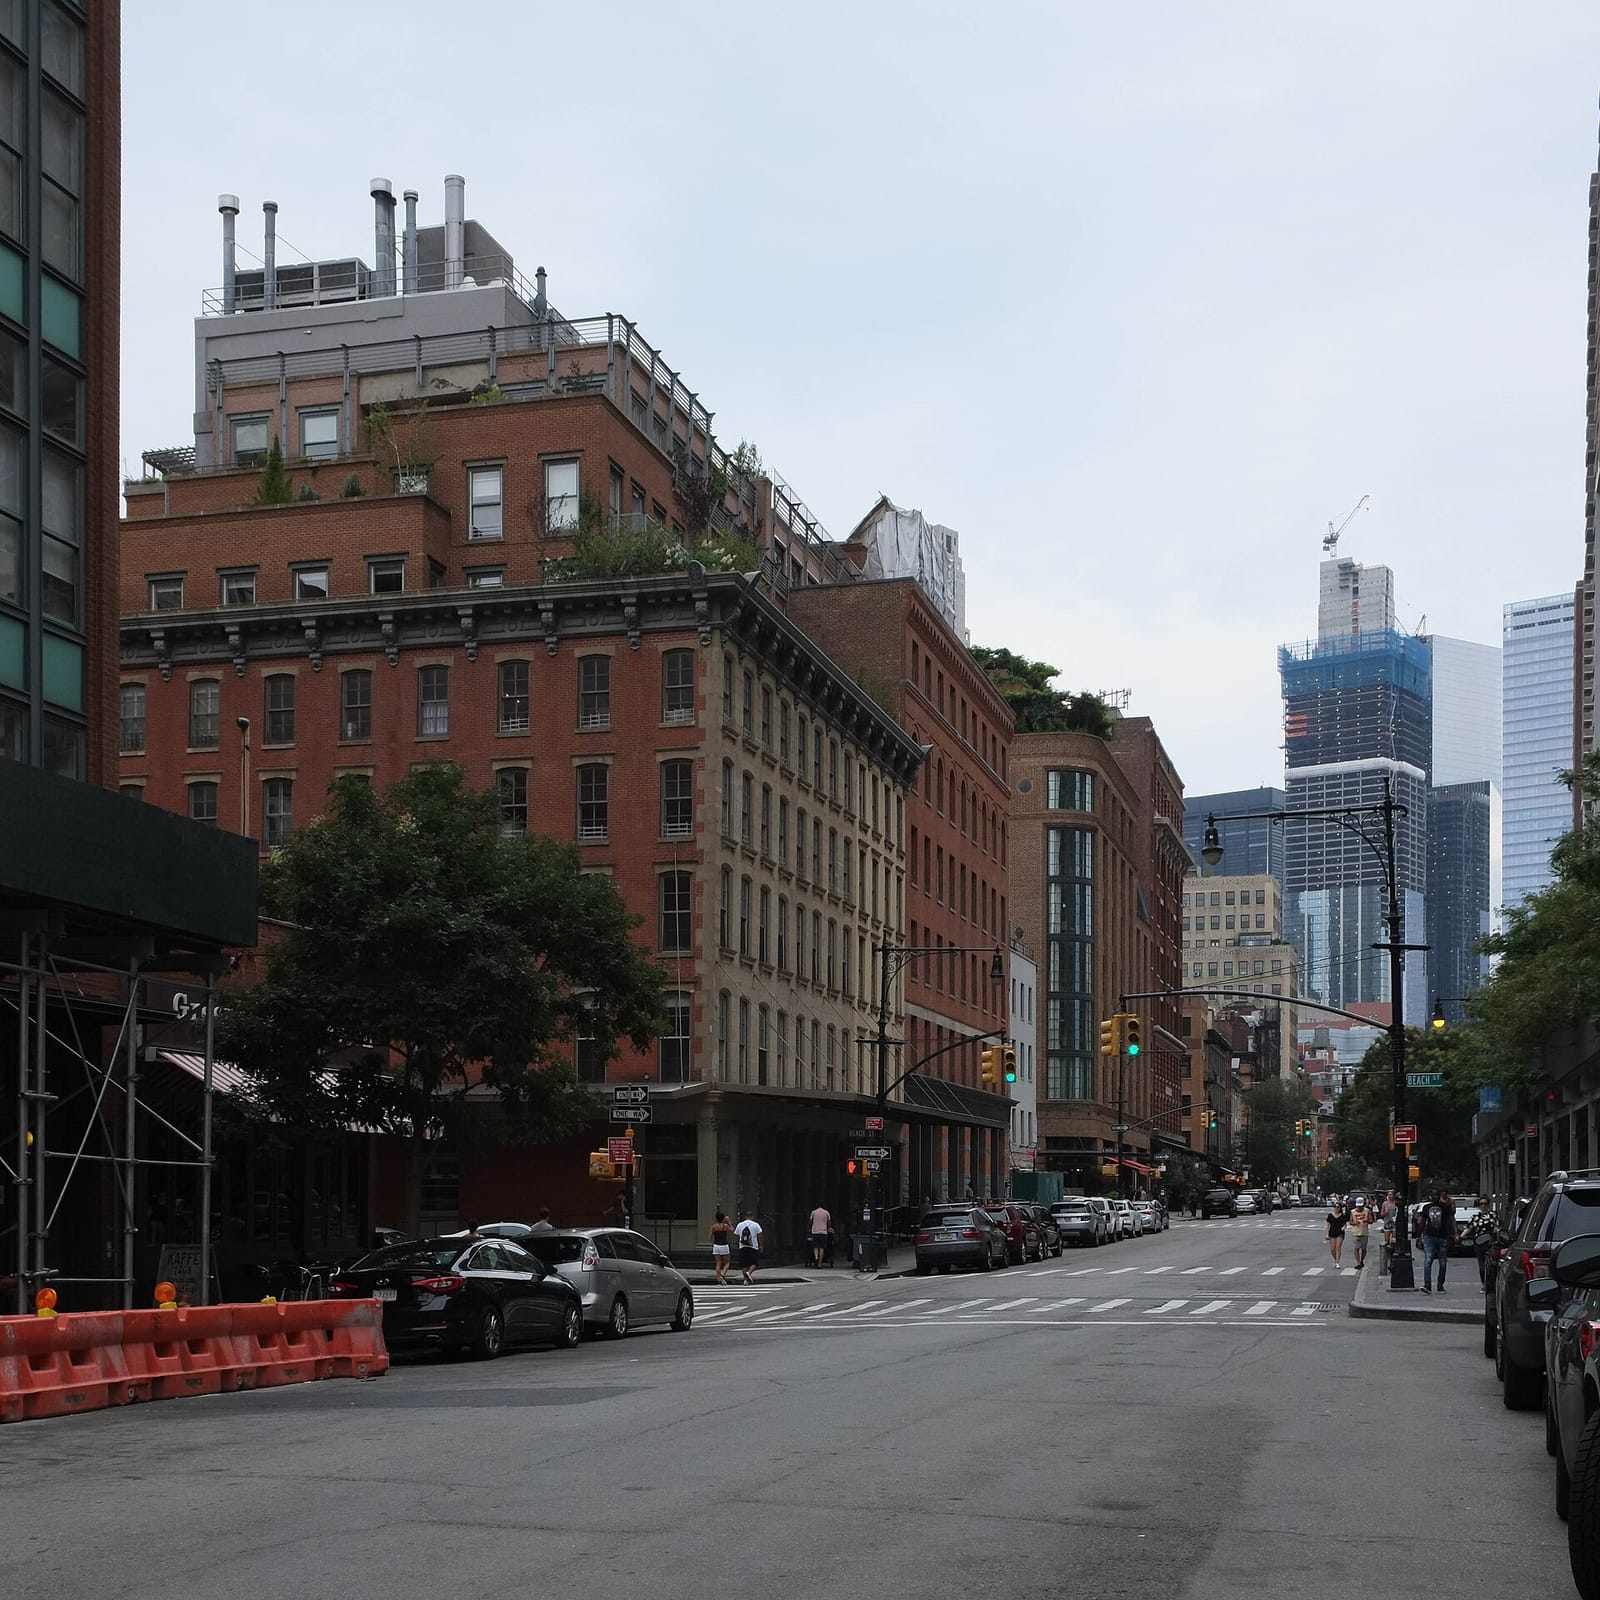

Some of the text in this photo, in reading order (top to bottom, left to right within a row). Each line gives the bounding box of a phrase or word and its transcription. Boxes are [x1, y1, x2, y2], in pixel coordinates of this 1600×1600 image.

[1407, 1075, 1430, 1085] BEACH
[615, 1110, 628, 1118] ONE
[167, 1252, 200, 1265] KAFFE
